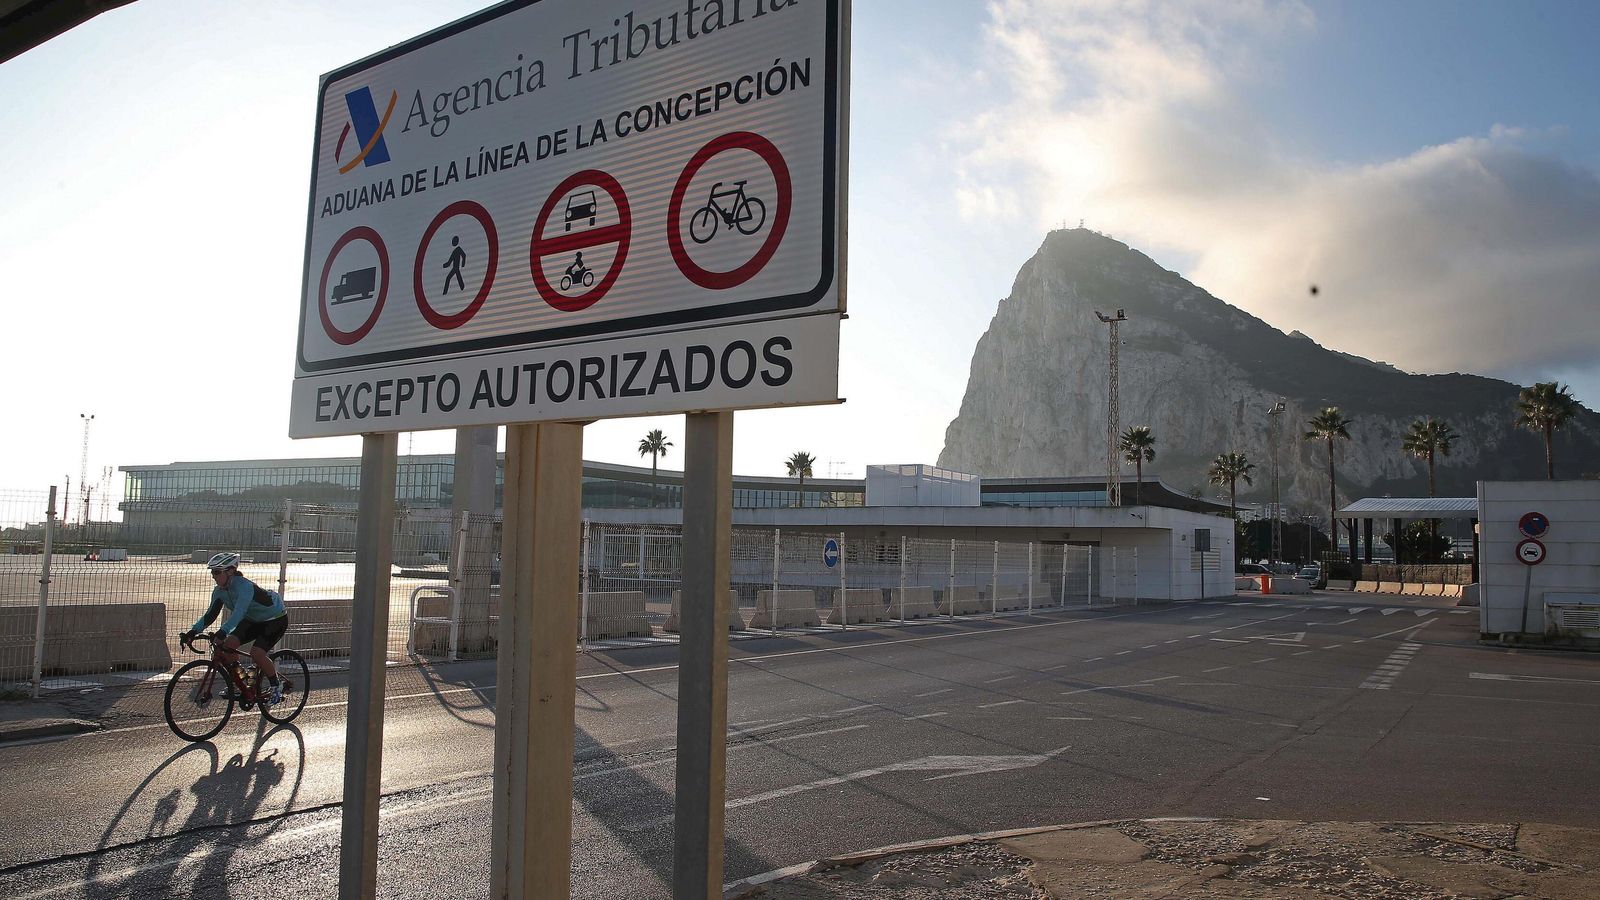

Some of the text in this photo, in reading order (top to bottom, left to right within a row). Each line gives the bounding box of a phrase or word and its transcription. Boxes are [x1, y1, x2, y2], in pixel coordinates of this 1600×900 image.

[320, 57, 812, 219] ADUANA DE LA LÍNEA DE LA CONCEPCIÓN
[401, 0, 798, 138] Agencia Tributar
[315, 336, 794, 423] EXCEPTO AUTORIZADOS
